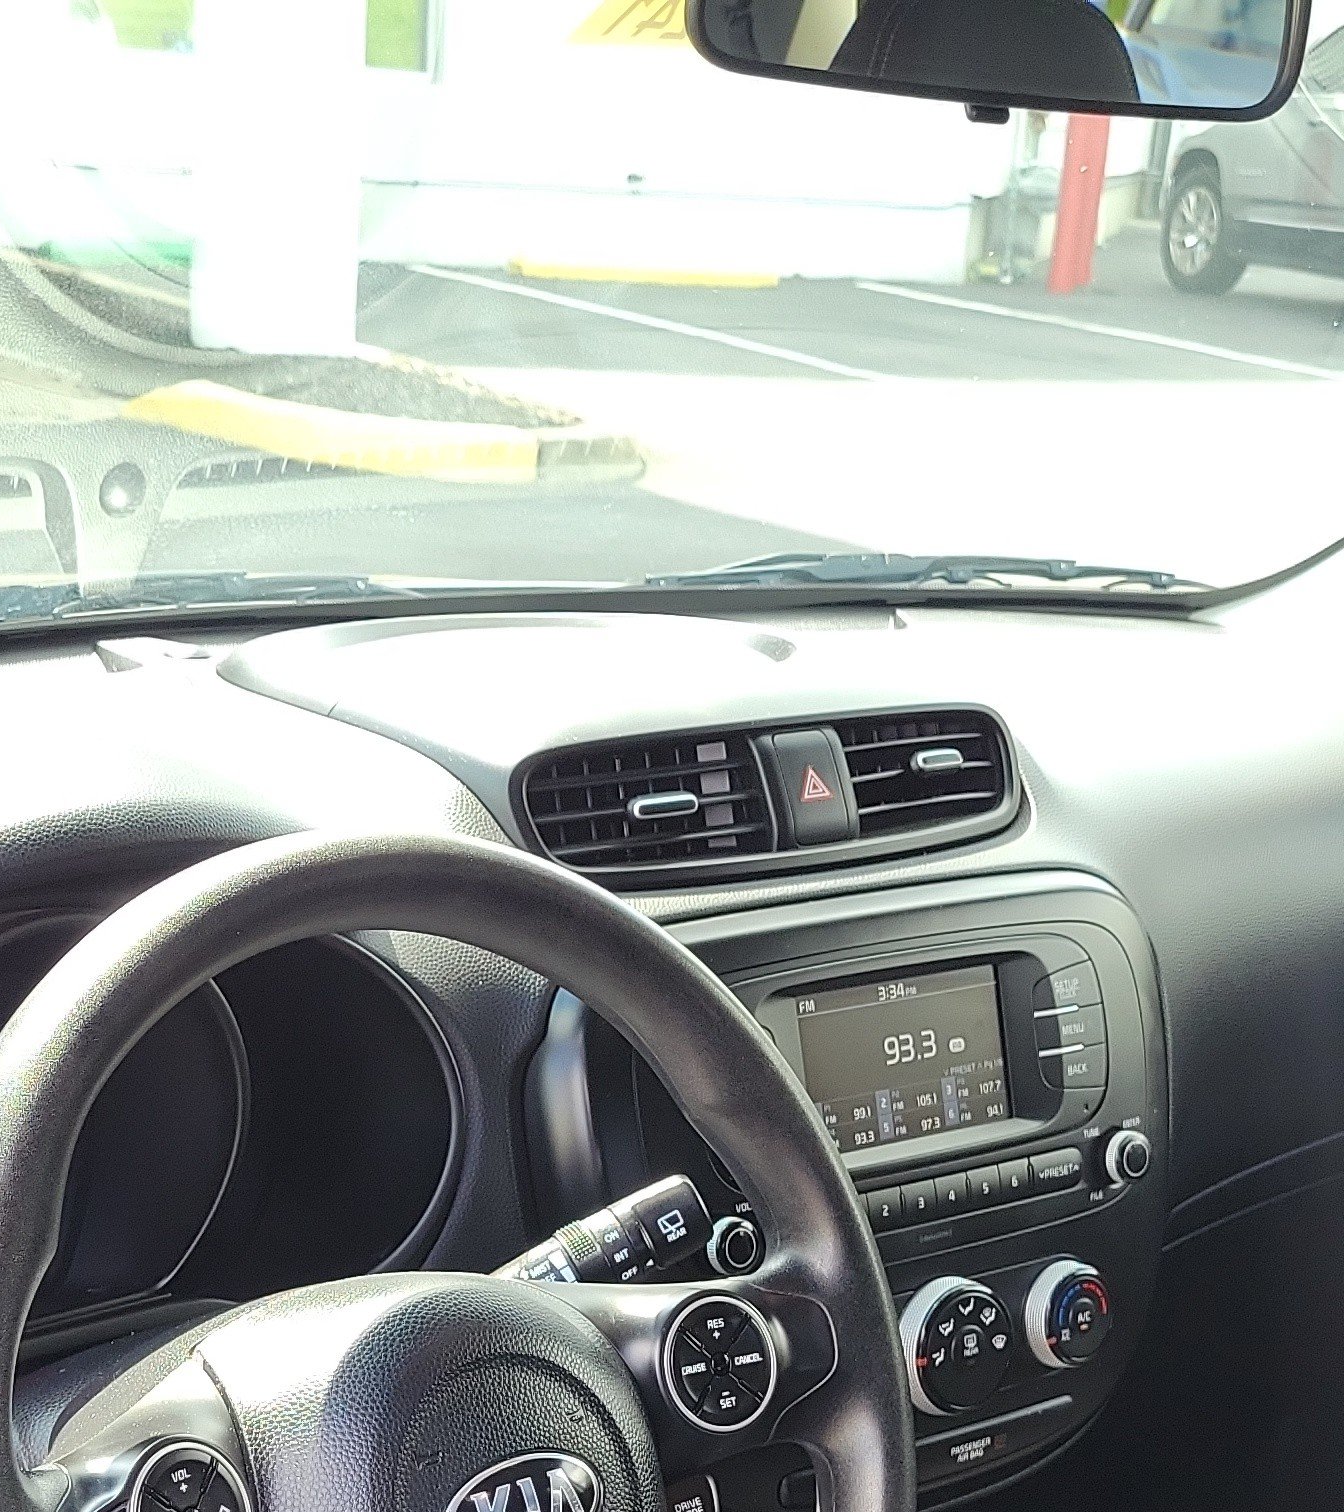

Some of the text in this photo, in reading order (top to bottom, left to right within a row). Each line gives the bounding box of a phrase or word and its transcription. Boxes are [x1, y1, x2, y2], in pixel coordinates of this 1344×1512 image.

[878, 982, 906, 1001] 3:34
[798, 999, 816, 1014] FM
[1062, 1022, 1084, 1035] MENU
[883, 1028, 937, 1066] 93.3
[979, 1079, 1002, 1095] 107.7
[880, 1097, 887, 1109] 2
[882, 1175, 1018, 1217] 2 3 4 5 6
[735, 1202, 753, 1213] VOL
[604, 1231, 620, 1243] ON
[666, 1226, 687, 1243] REAR
[613, 1248, 630, 1262] INT
[621, 1266, 639, 1281] OFF
[707, 1318, 725, 1330] RES
[681, 1352, 764, 1376] CRUISE CANCEL
[719, 1396, 737, 1410] SET
[950, 1436, 992, 1457] PASSENGER
[171, 1468, 192, 1483] VOL
